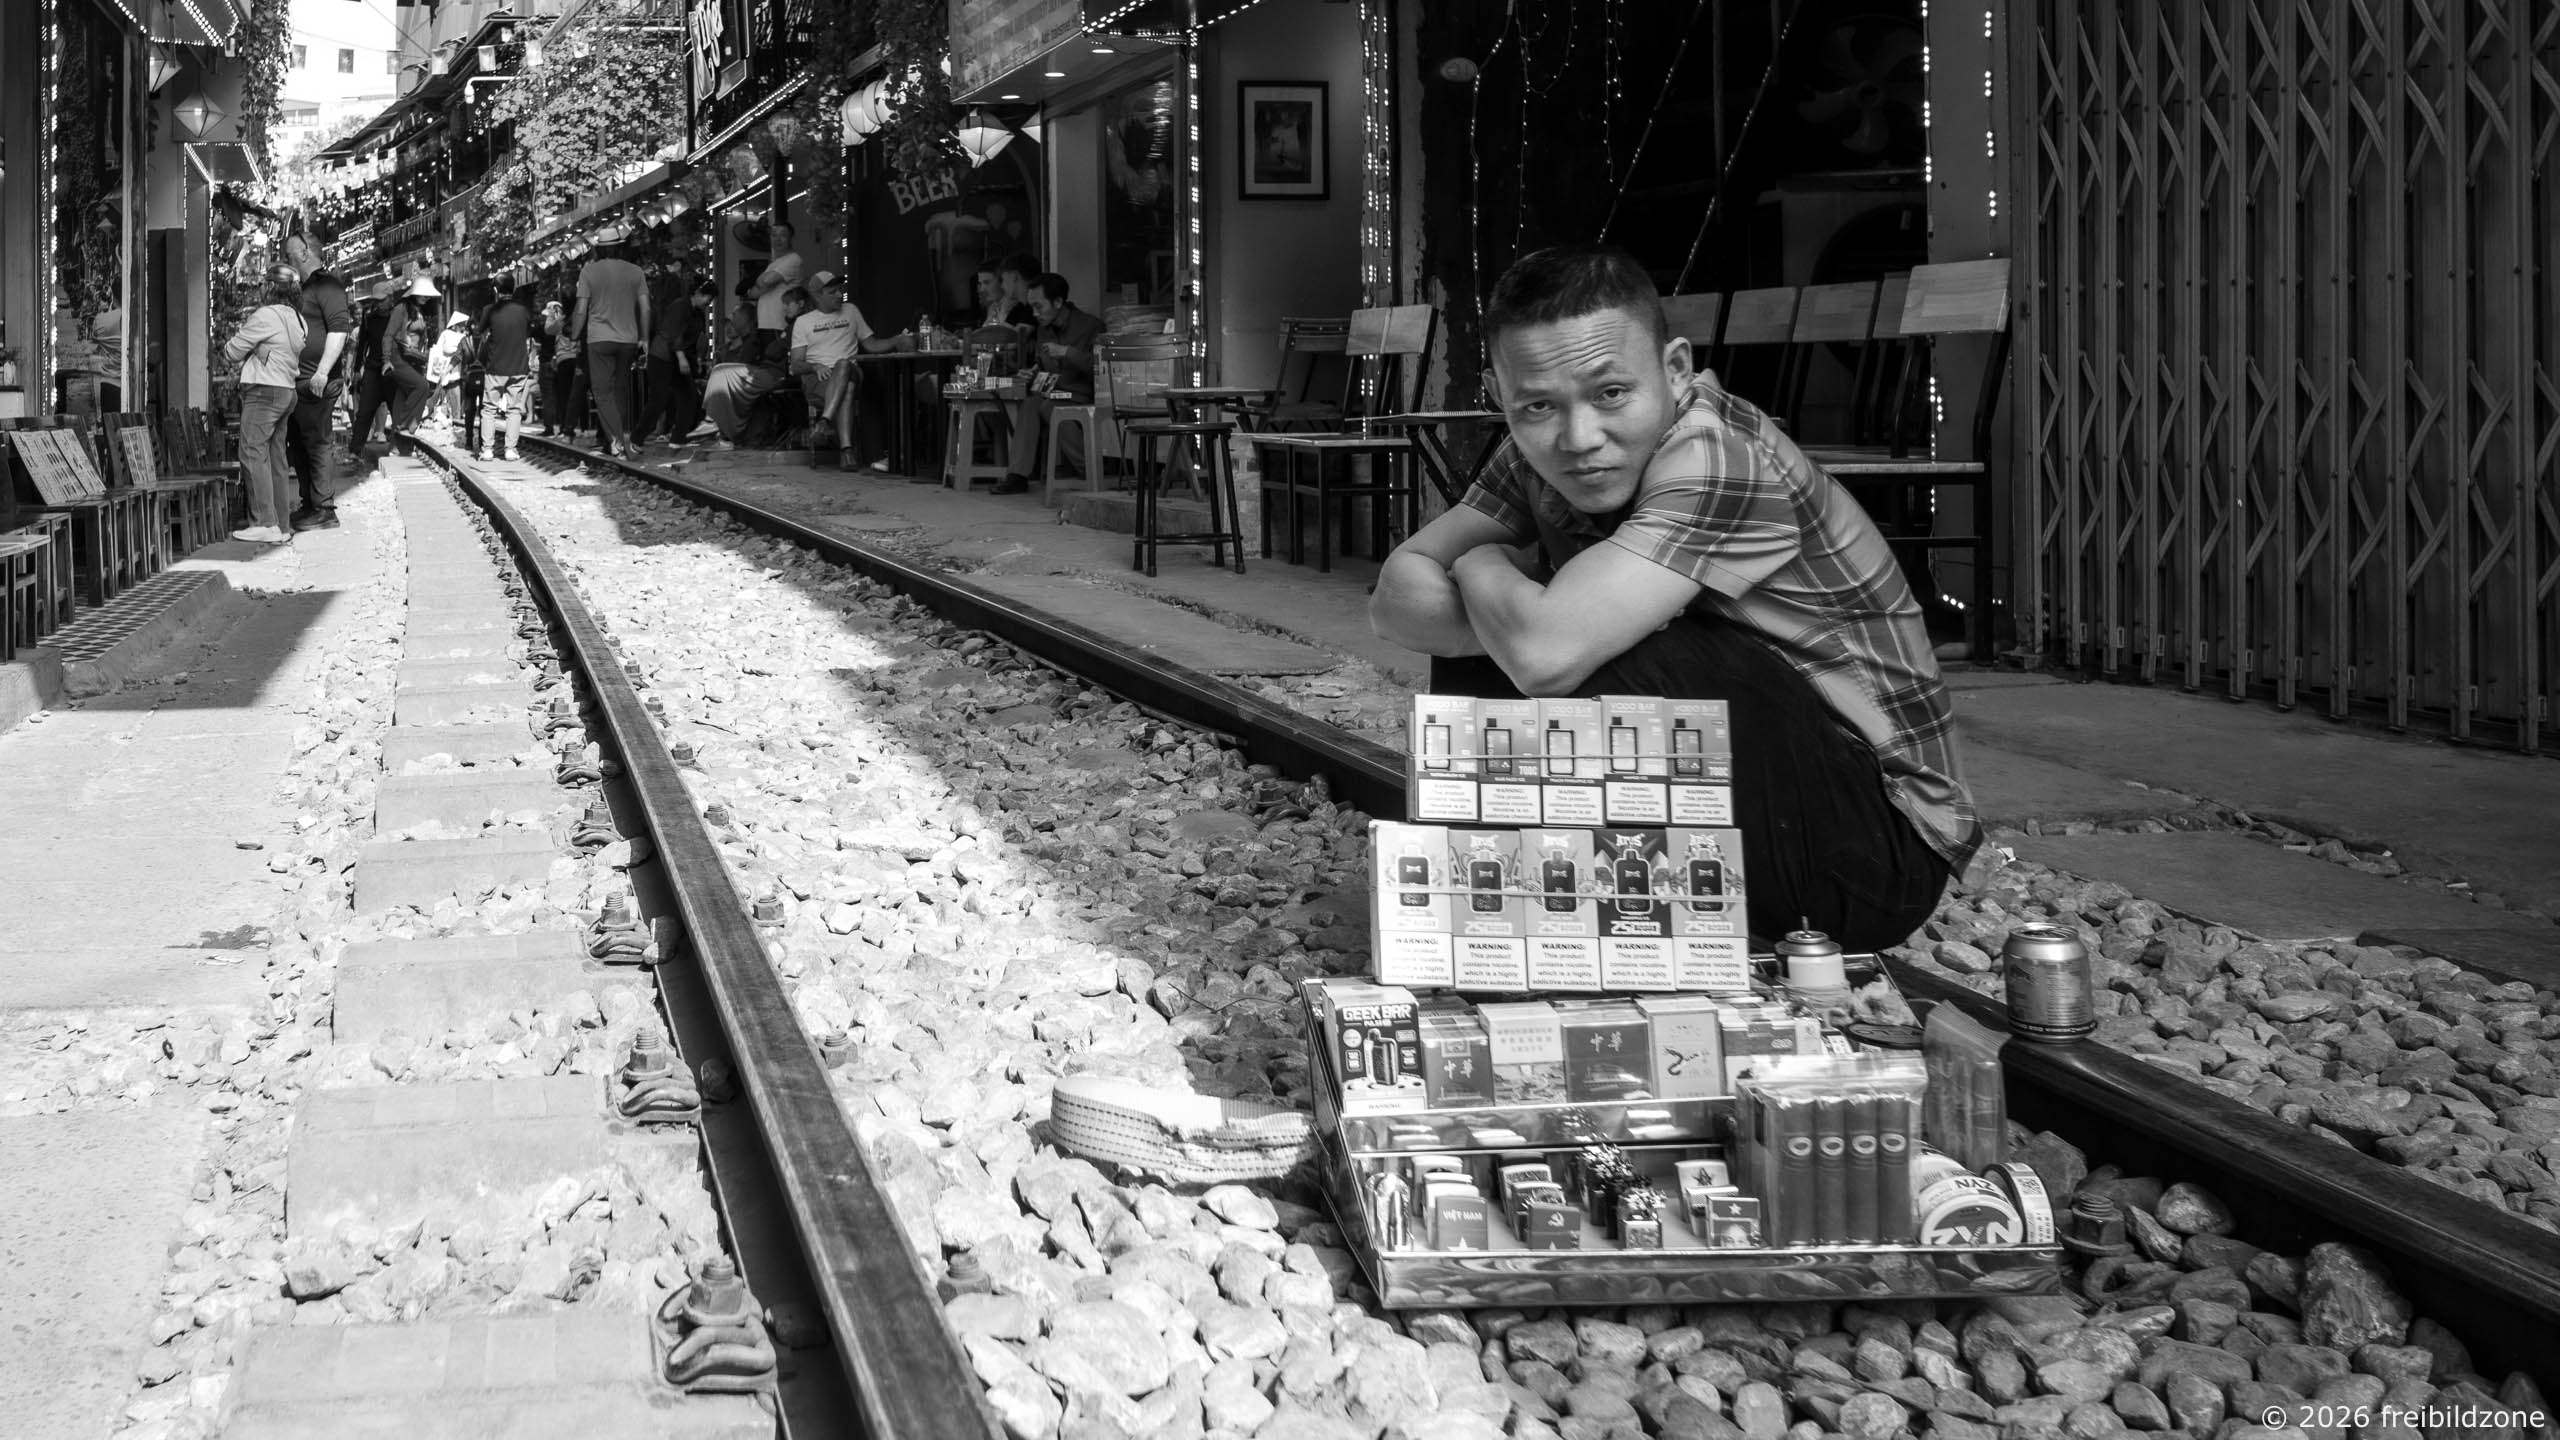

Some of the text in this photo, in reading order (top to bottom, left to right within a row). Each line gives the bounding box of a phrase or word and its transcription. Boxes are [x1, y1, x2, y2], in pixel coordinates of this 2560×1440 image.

[889, 167, 960, 215] BEER
[1342, 1004, 1412, 1022] GEEK BAR
